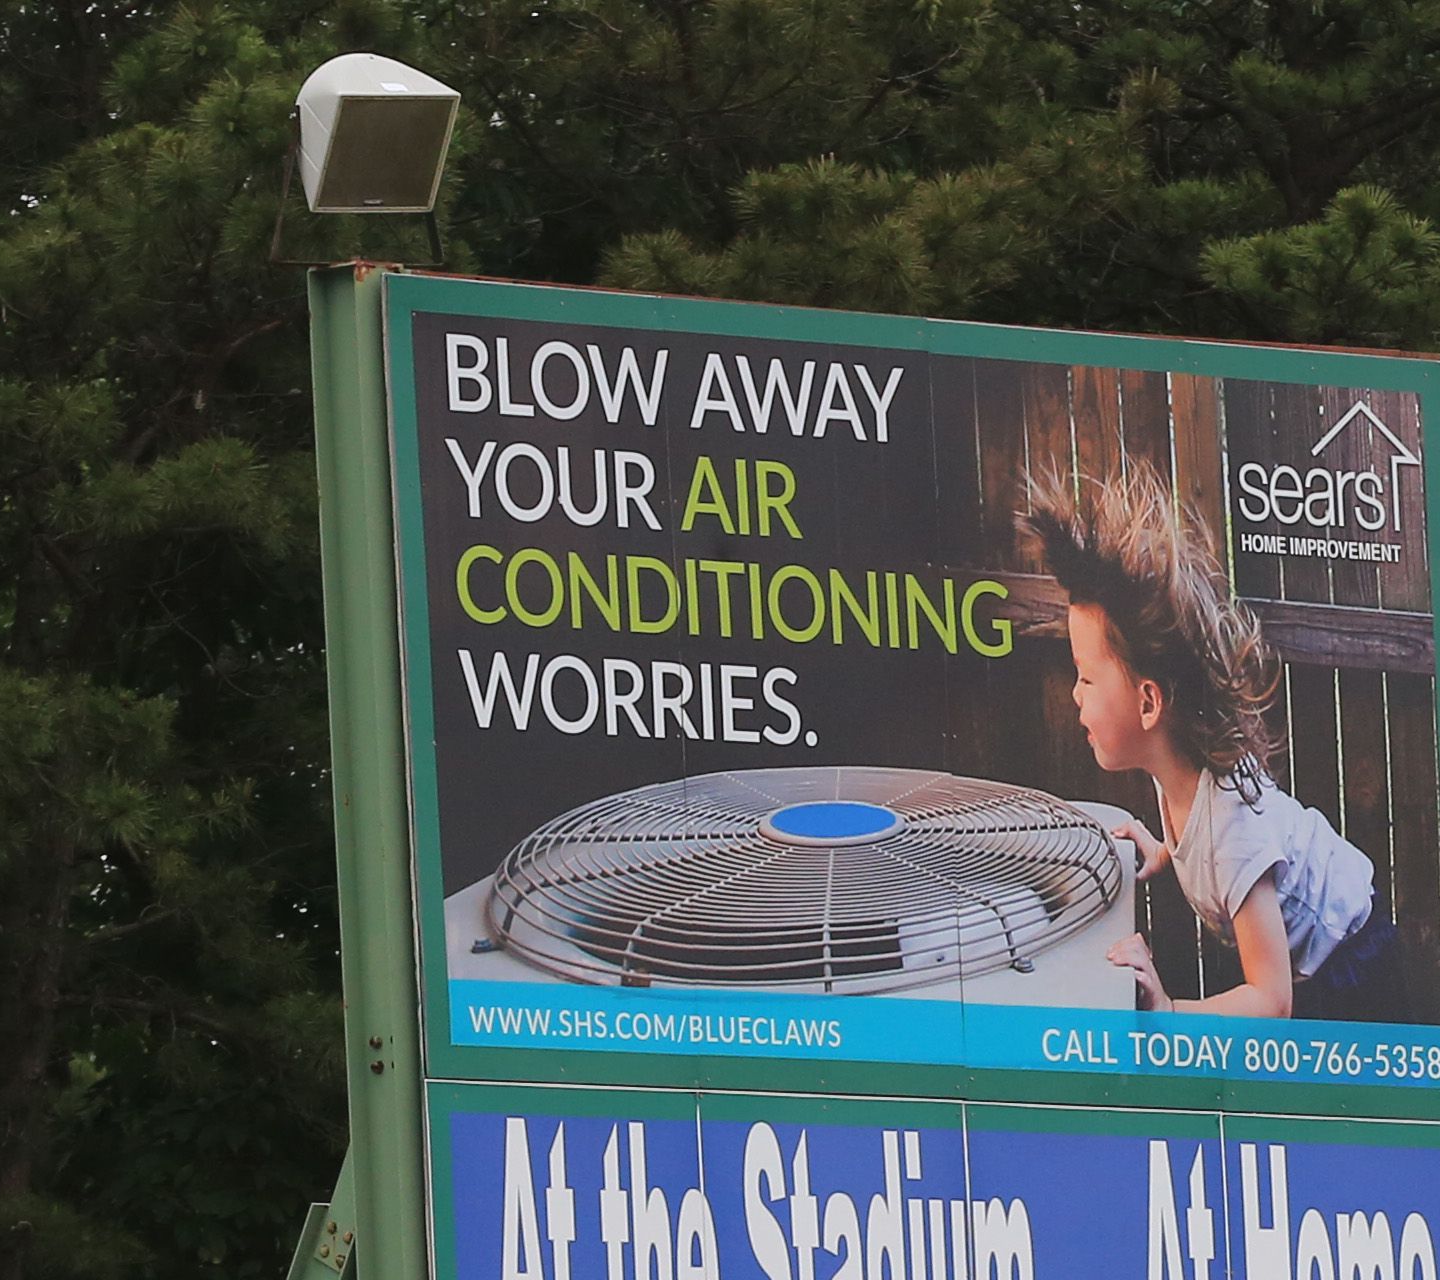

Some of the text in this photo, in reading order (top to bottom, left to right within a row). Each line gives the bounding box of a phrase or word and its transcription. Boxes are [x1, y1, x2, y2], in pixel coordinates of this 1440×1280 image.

[443, 332, 903, 444] BLOW AWAY
[448, 438, 803, 541] YOUR AIR
[1238, 462, 1386, 531] sears
[1241, 533, 1401, 562] HOME IMPROVEMENT
[456, 544, 1015, 658] CONDITIONING
[457, 648, 818, 747] WORRIES.
[468, 1004, 842, 1048] WWW.SHS.COM/BLUECLAWS
[1042, 1028, 1118, 1065] CALL
[1128, 1032, 1232, 1070] TODAY
